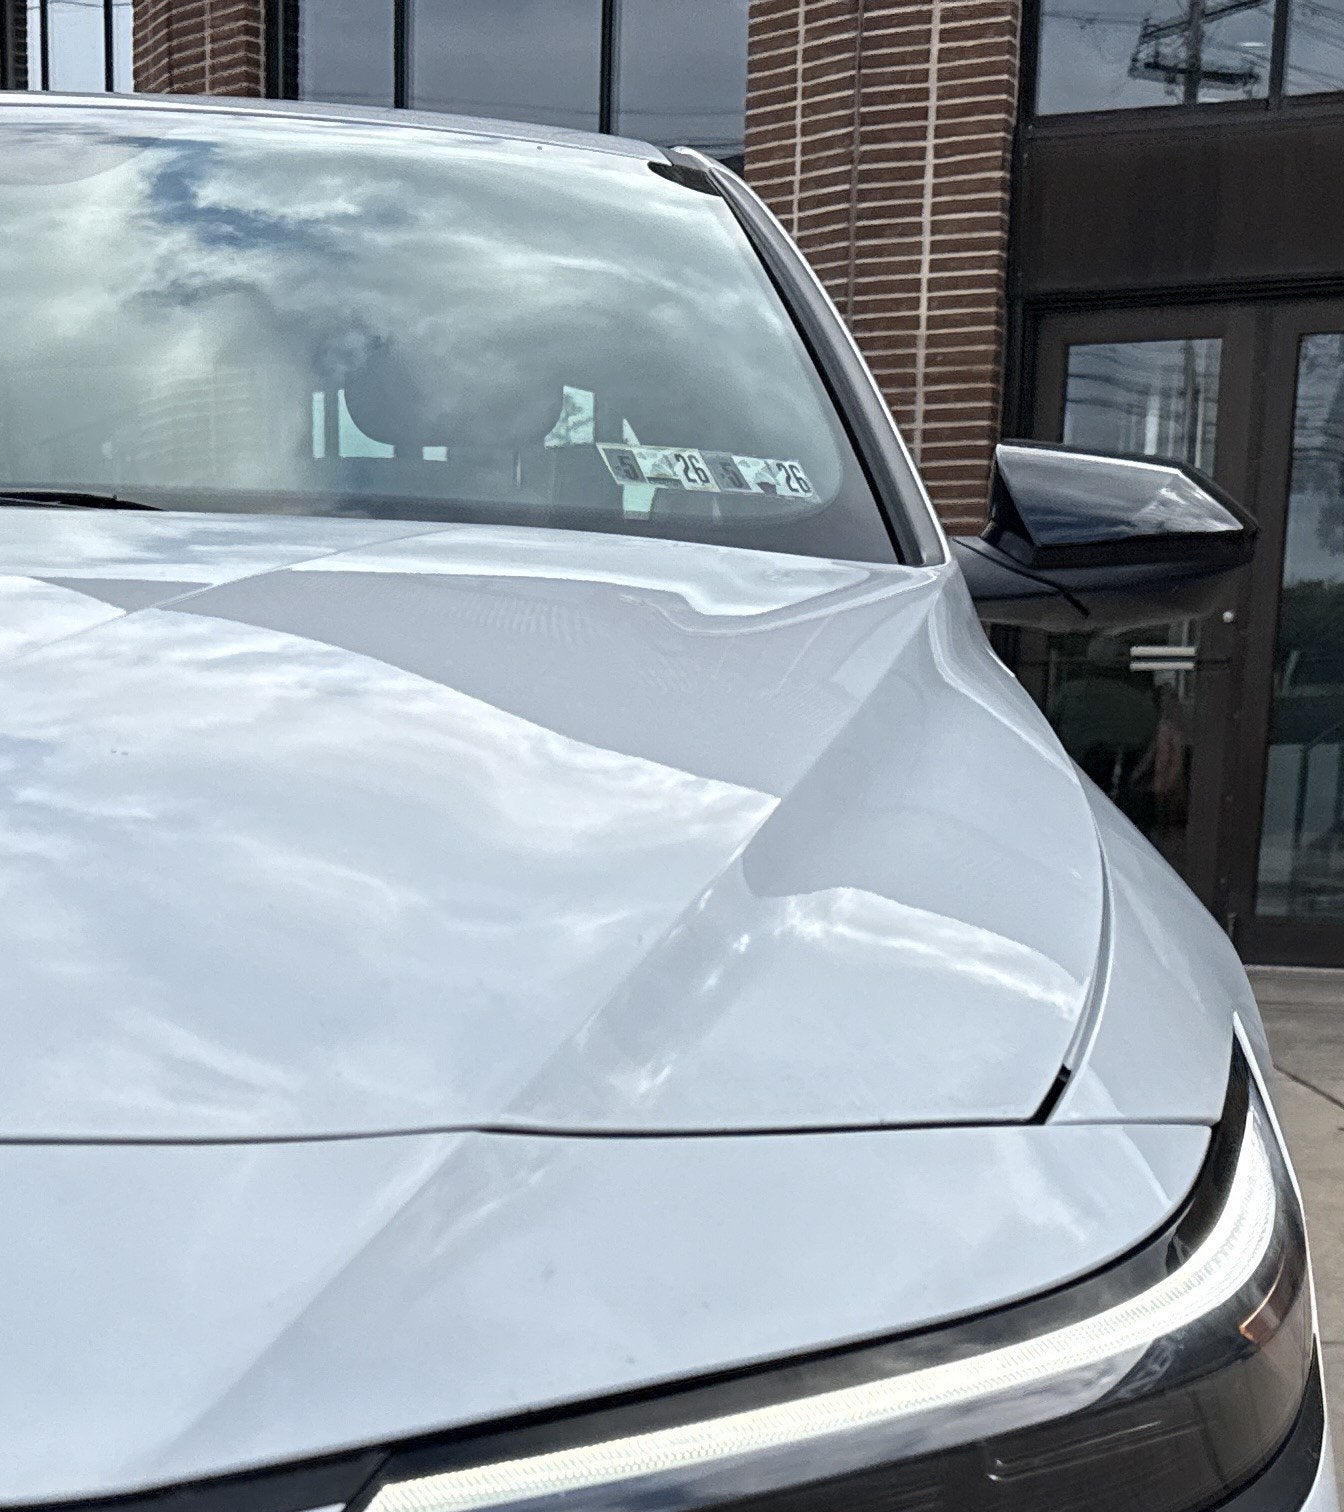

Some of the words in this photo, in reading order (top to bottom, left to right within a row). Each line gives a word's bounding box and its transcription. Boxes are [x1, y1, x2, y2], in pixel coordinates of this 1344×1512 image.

[617, 455, 639, 480] 5
[674, 453, 710, 483] 26
[719, 461, 743, 488] 5
[776, 462, 811, 493] 26
